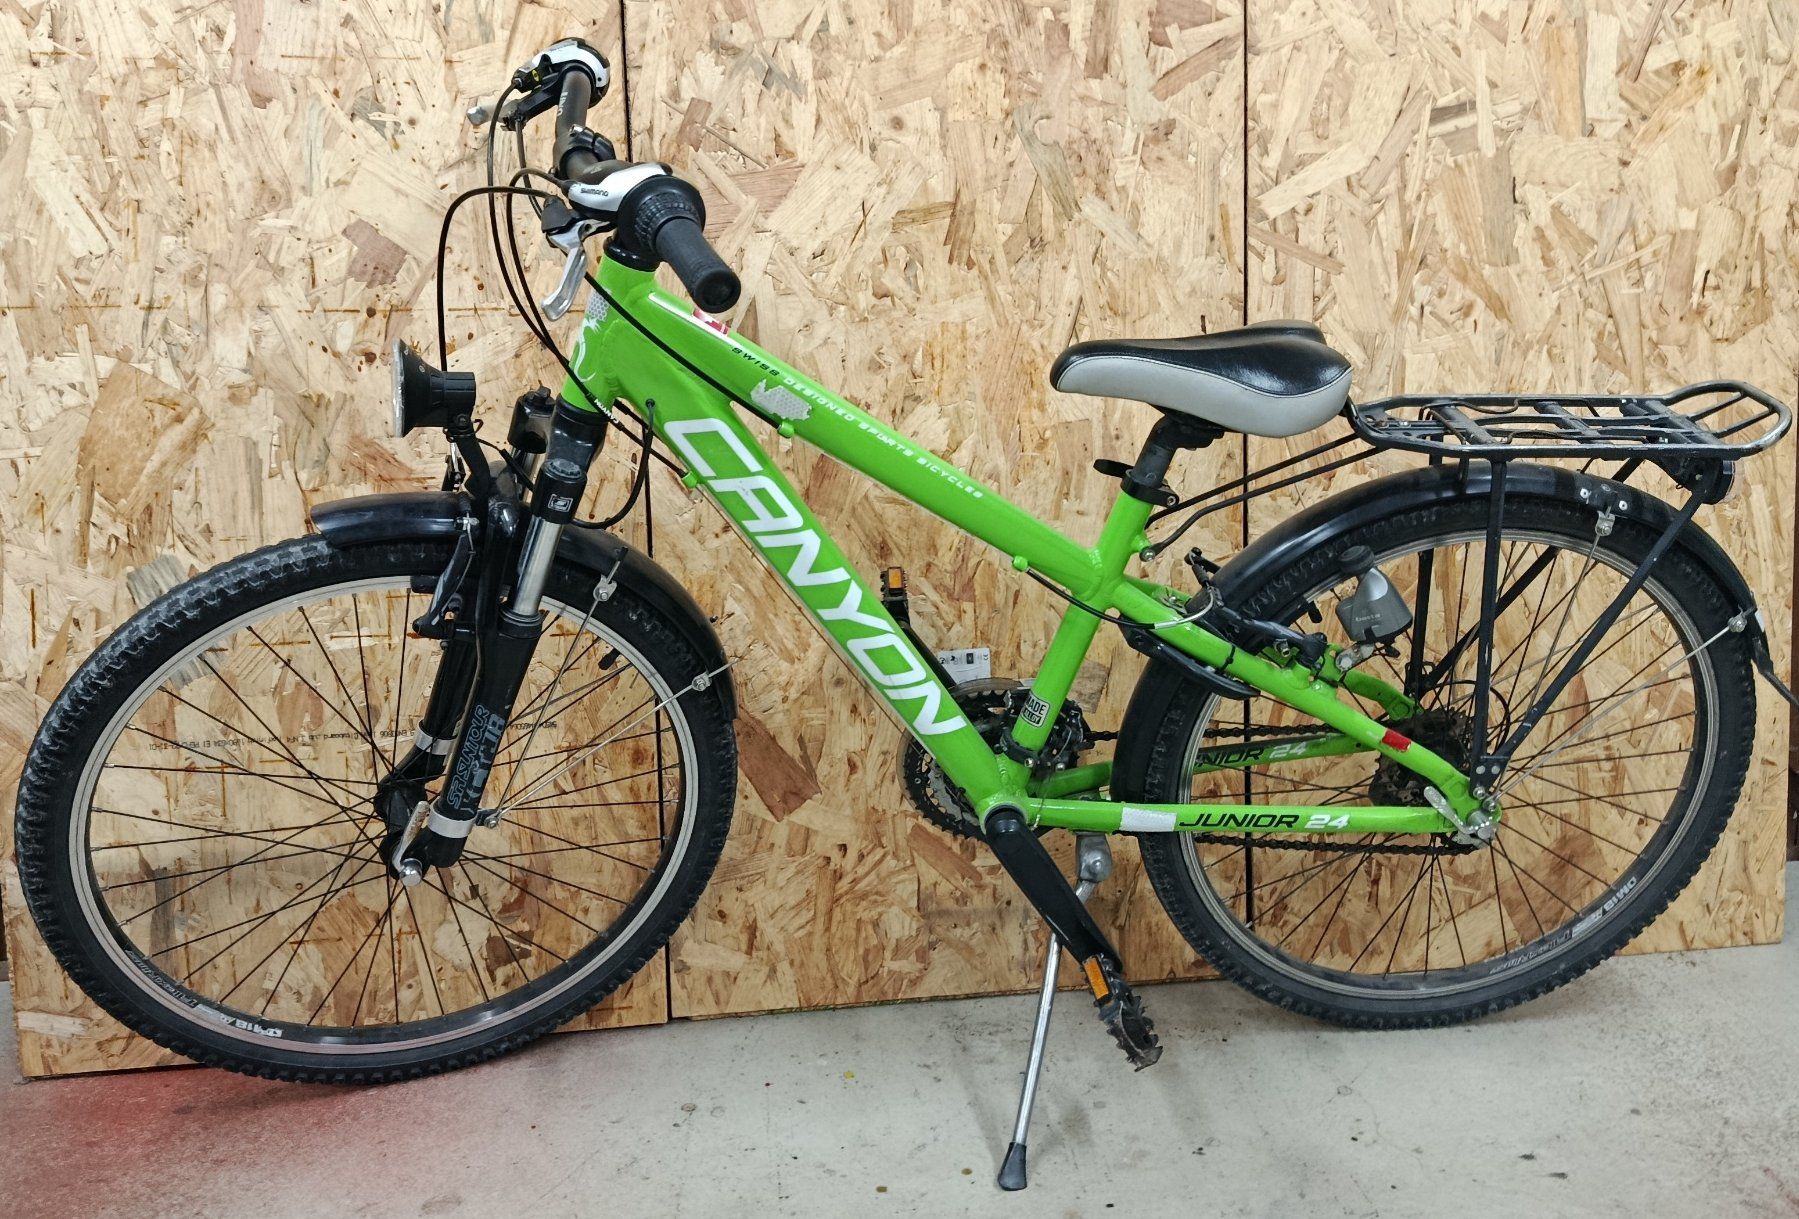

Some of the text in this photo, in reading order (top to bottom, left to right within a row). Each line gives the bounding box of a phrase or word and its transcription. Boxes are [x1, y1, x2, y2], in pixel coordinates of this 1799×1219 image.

[580, 187, 609, 197] SHIMANO
[732, 347, 984, 499] SWISS DESIGNED SPORTS BICYCLES
[664, 417, 967, 736] CANYON
[456, 704, 490, 780] SUNTOUR
[1196, 741, 1307, 767] NIOR 24
[1180, 813, 1350, 830] JUNIOR 24
